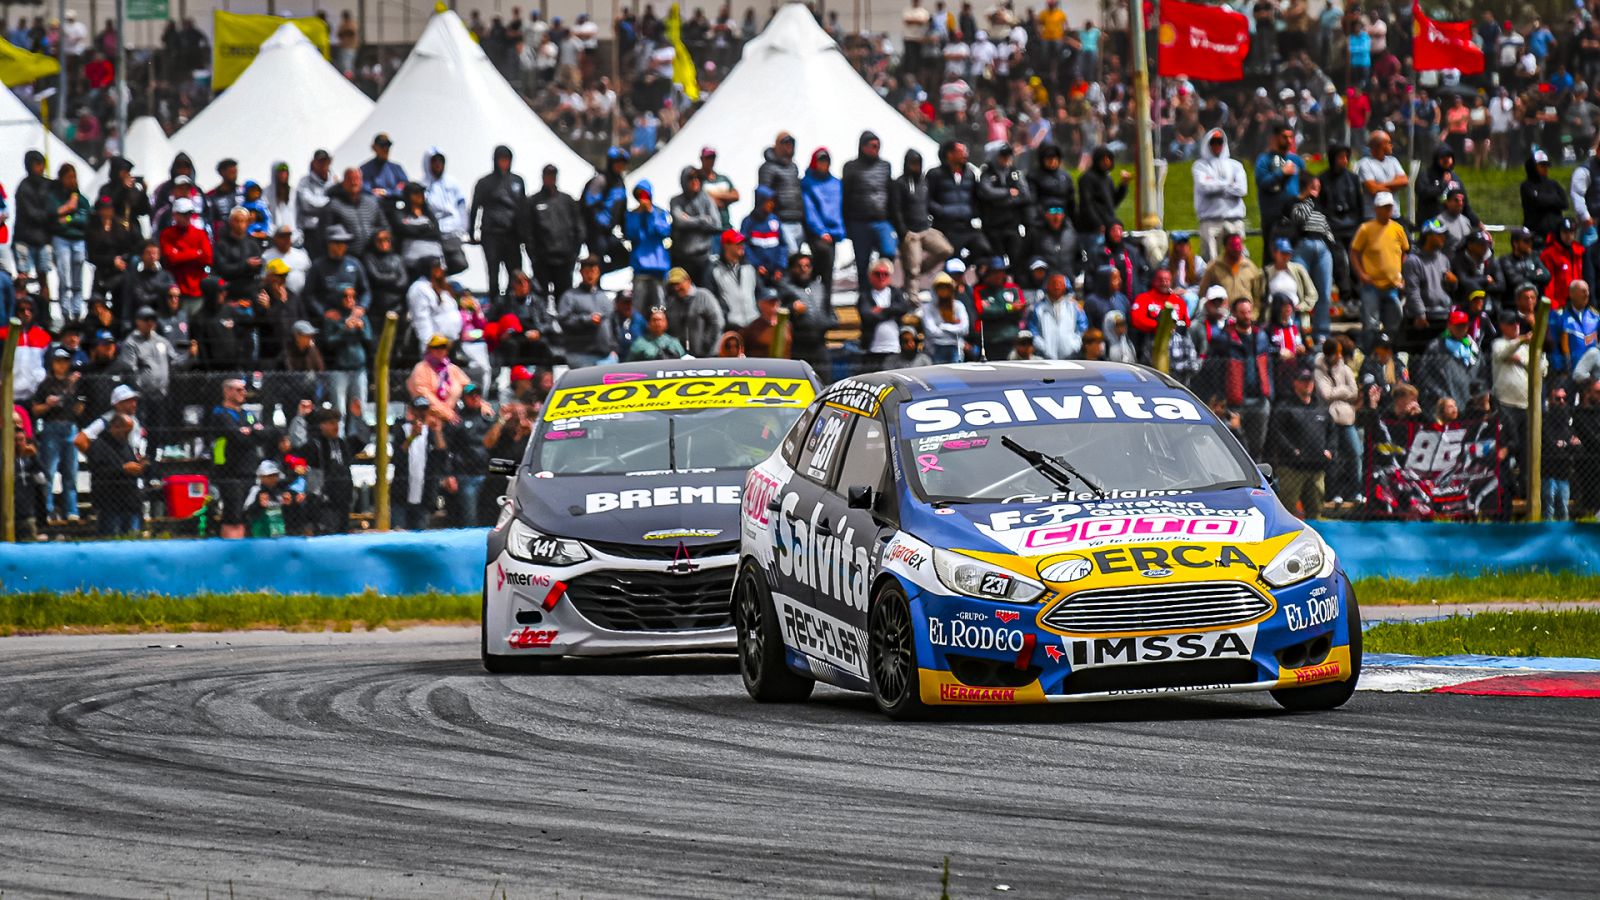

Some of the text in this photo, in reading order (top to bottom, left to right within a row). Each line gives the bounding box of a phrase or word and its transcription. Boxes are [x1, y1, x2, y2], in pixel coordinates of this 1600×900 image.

[550, 401, 671, 418] CONCESIONARIO
[556, 380, 801, 409] ROYCAN
[906, 385, 1201, 433] Salvita
[1405, 428, 1467, 472] 86
[1025, 517, 1239, 548] COTO
[533, 539, 557, 558] 141
[780, 492, 870, 613] Salvita
[1092, 545, 1257, 575] ERCA
[981, 576, 1008, 595] 231
[1283, 595, 1340, 632] EL RODEO
[928, 616, 1025, 652] EL RODEO
[1072, 633, 1251, 665] IMSSA
[1294, 662, 1340, 684] HERMANN
[940, 683, 1015, 702] HERMANN
